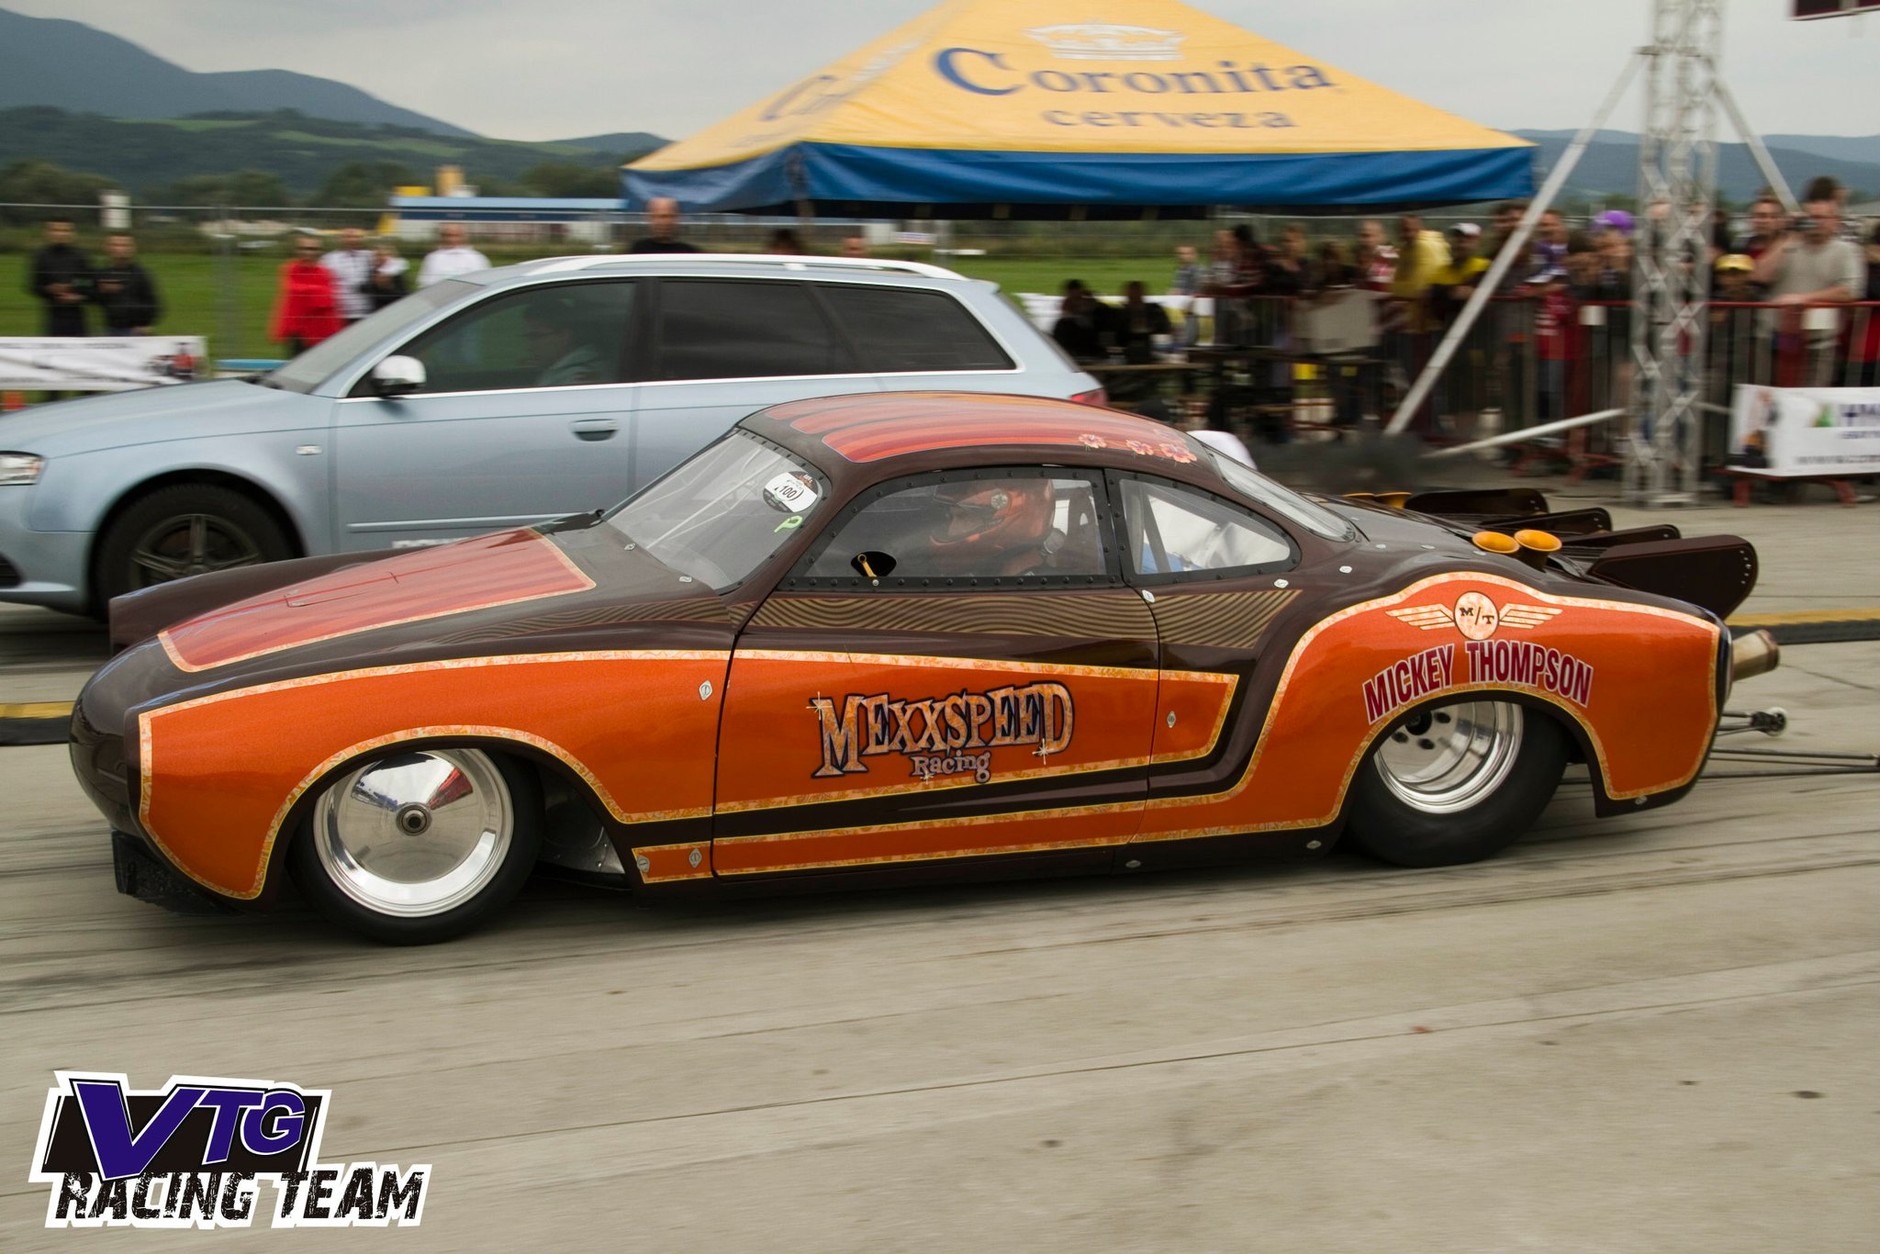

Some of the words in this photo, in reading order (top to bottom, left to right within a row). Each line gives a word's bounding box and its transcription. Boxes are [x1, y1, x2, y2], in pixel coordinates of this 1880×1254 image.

[932, 47, 1335, 96] Coronita
[1041, 108, 1298, 129] cerveza
[1362, 643, 1455, 725] MICKEY
[1465, 639, 1594, 709] THOMPSON
[810, 681, 1074, 778] MEXXSPEED
[909, 751, 991, 783] Racing
